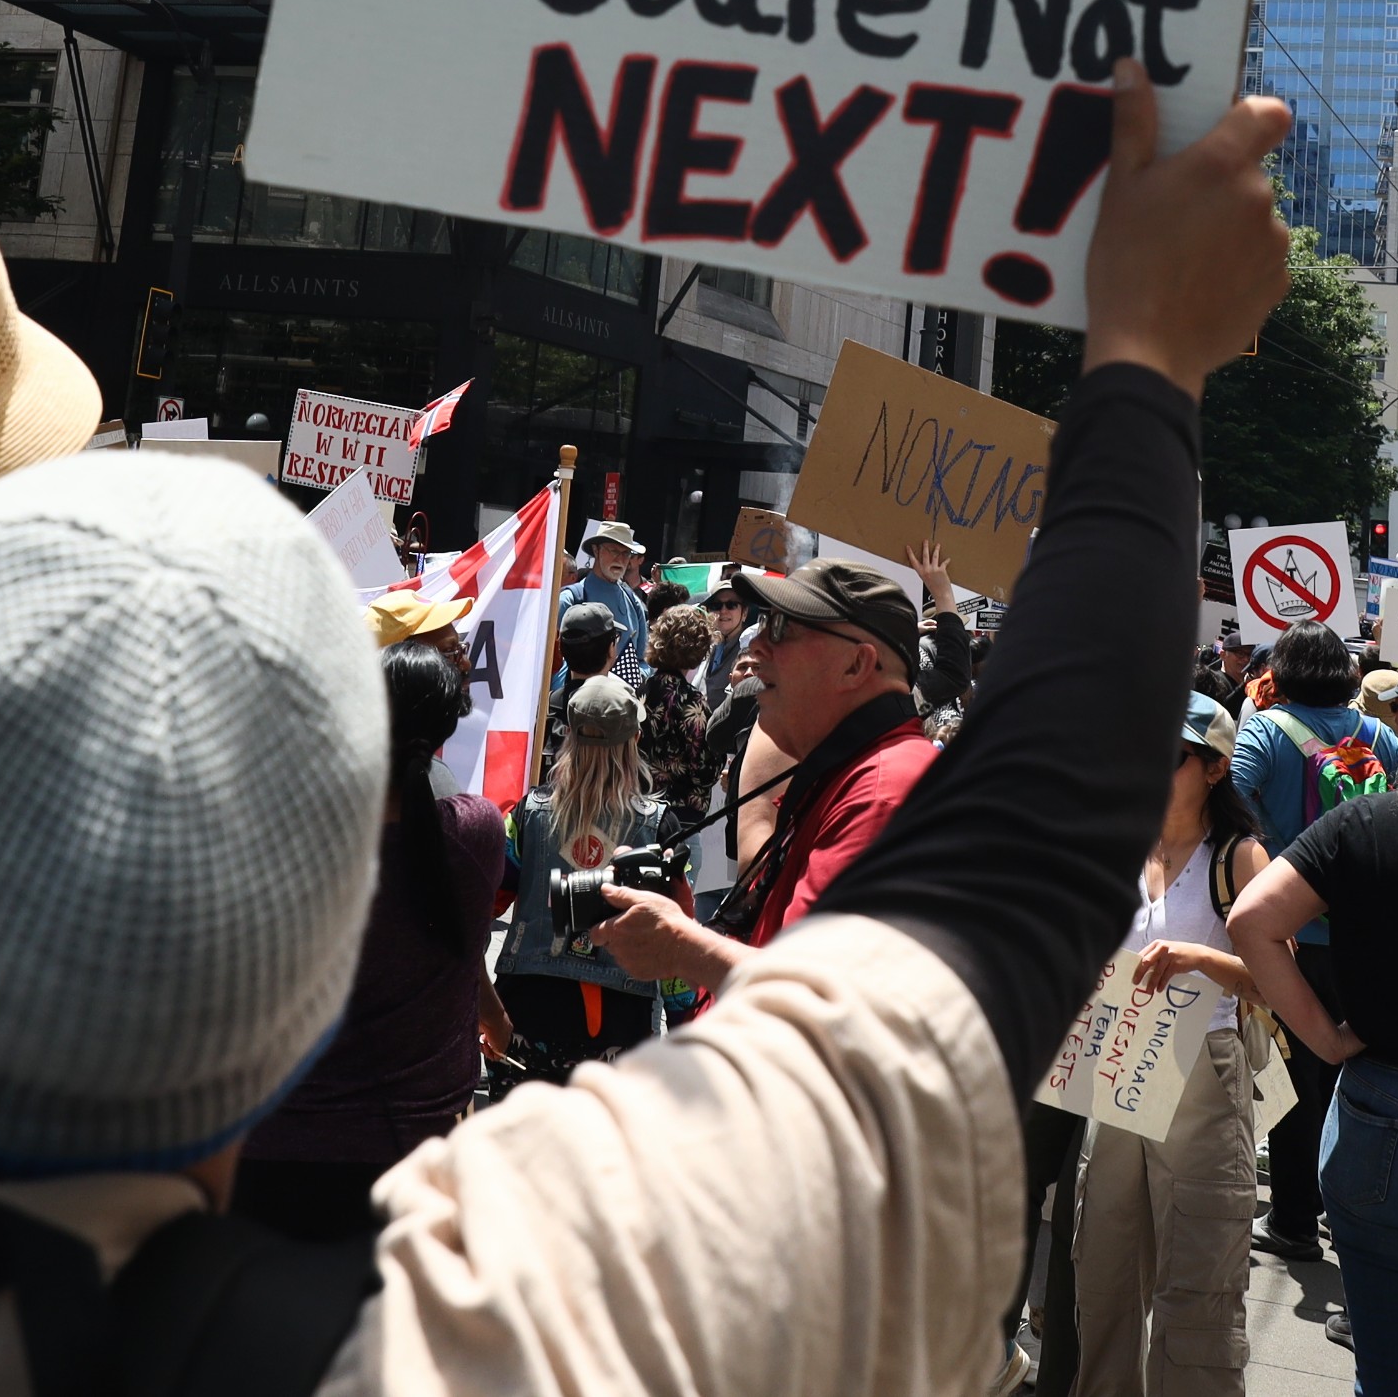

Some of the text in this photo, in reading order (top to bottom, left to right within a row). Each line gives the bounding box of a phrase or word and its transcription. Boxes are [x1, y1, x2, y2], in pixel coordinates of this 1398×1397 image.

[498, 42, 1118, 308] NEXT!
[219, 273, 361, 299] ALLSAINTS
[542, 305, 612, 339] ALLSAINTS
[934, 311, 949, 376] HORA
[297, 400, 418, 443] NORWEGIAN
[287, 452, 412, 502] RESISNCE
[1203, 566, 1234, 578] COMMAND
[1083, 1002, 1120, 1058] FEAR
[1098, 986, 1154, 1089] DOESN'T
[1114, 983, 1201, 1113] DEMOCRACY
